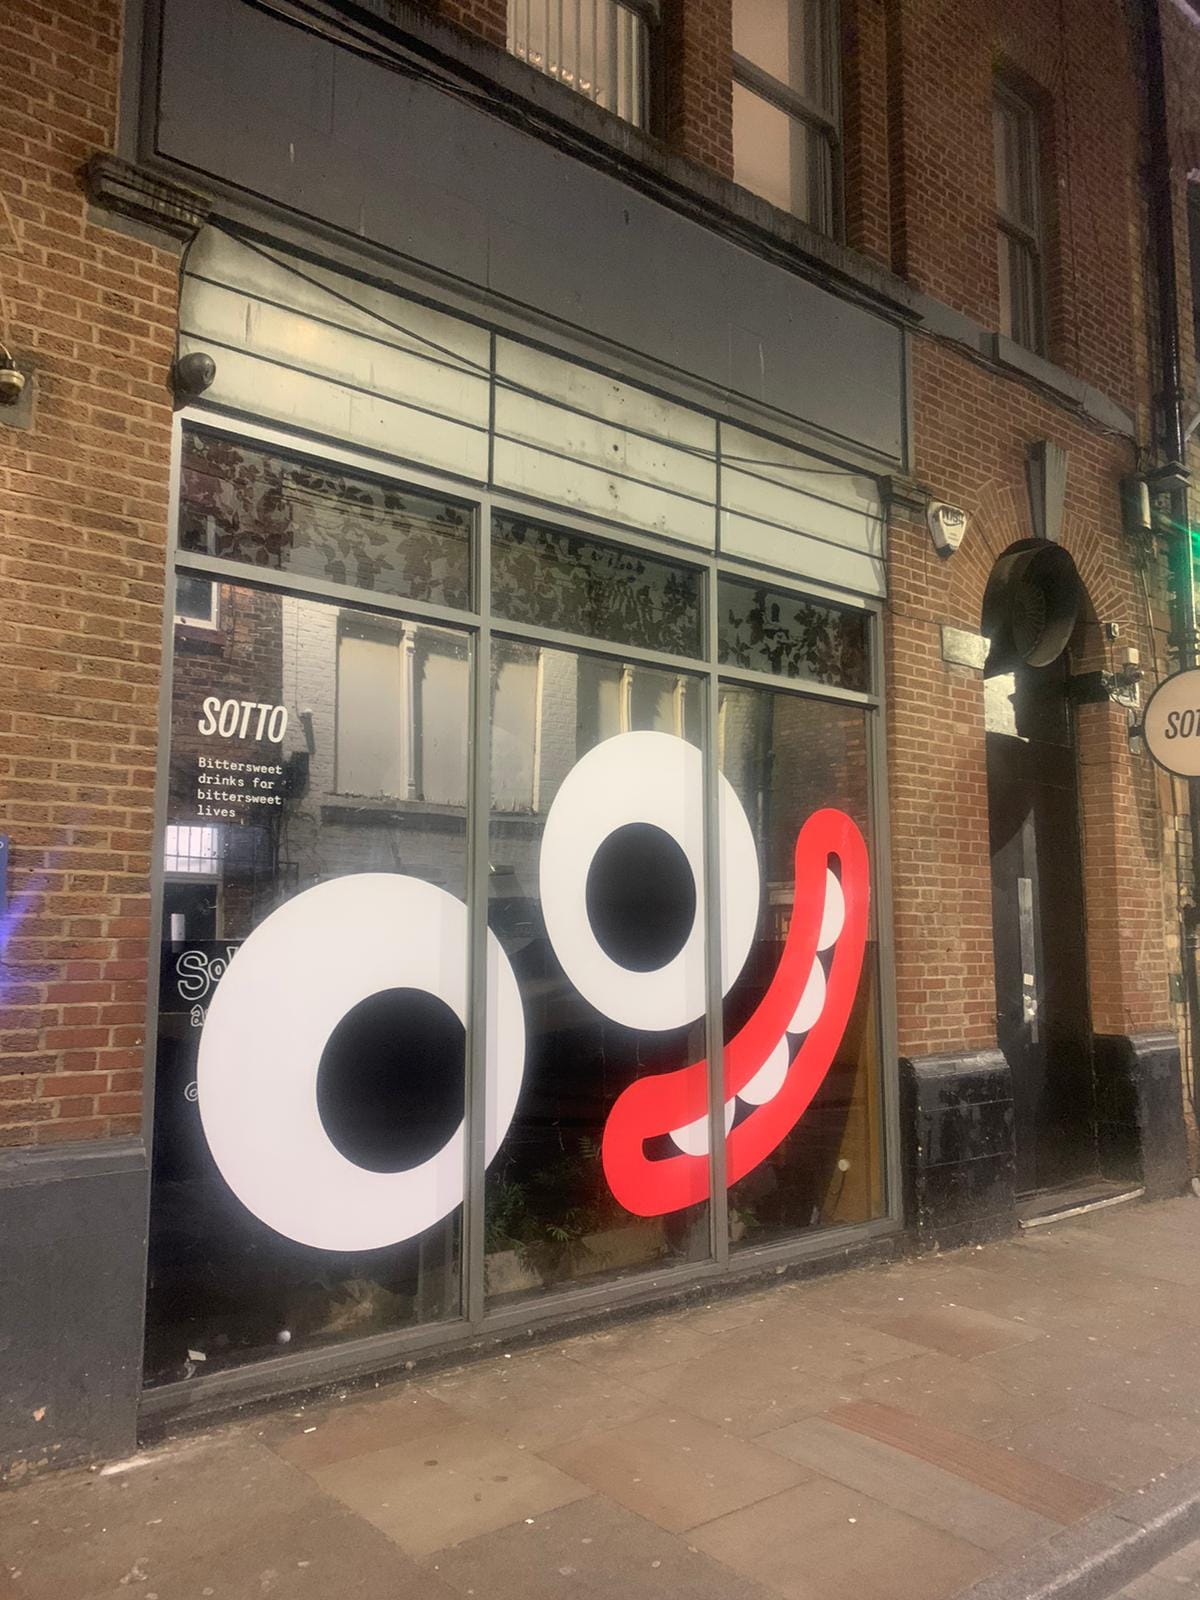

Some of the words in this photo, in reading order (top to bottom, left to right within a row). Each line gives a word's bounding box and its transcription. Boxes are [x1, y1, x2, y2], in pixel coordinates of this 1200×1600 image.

[198, 696, 288, 743] SOTTO
[198, 756, 283, 775] Bittersweet
[198, 773, 244, 787] drinks
[252, 777, 275, 789] for
[197, 789, 282, 805] bittersweet
[197, 804, 236, 817] lives
